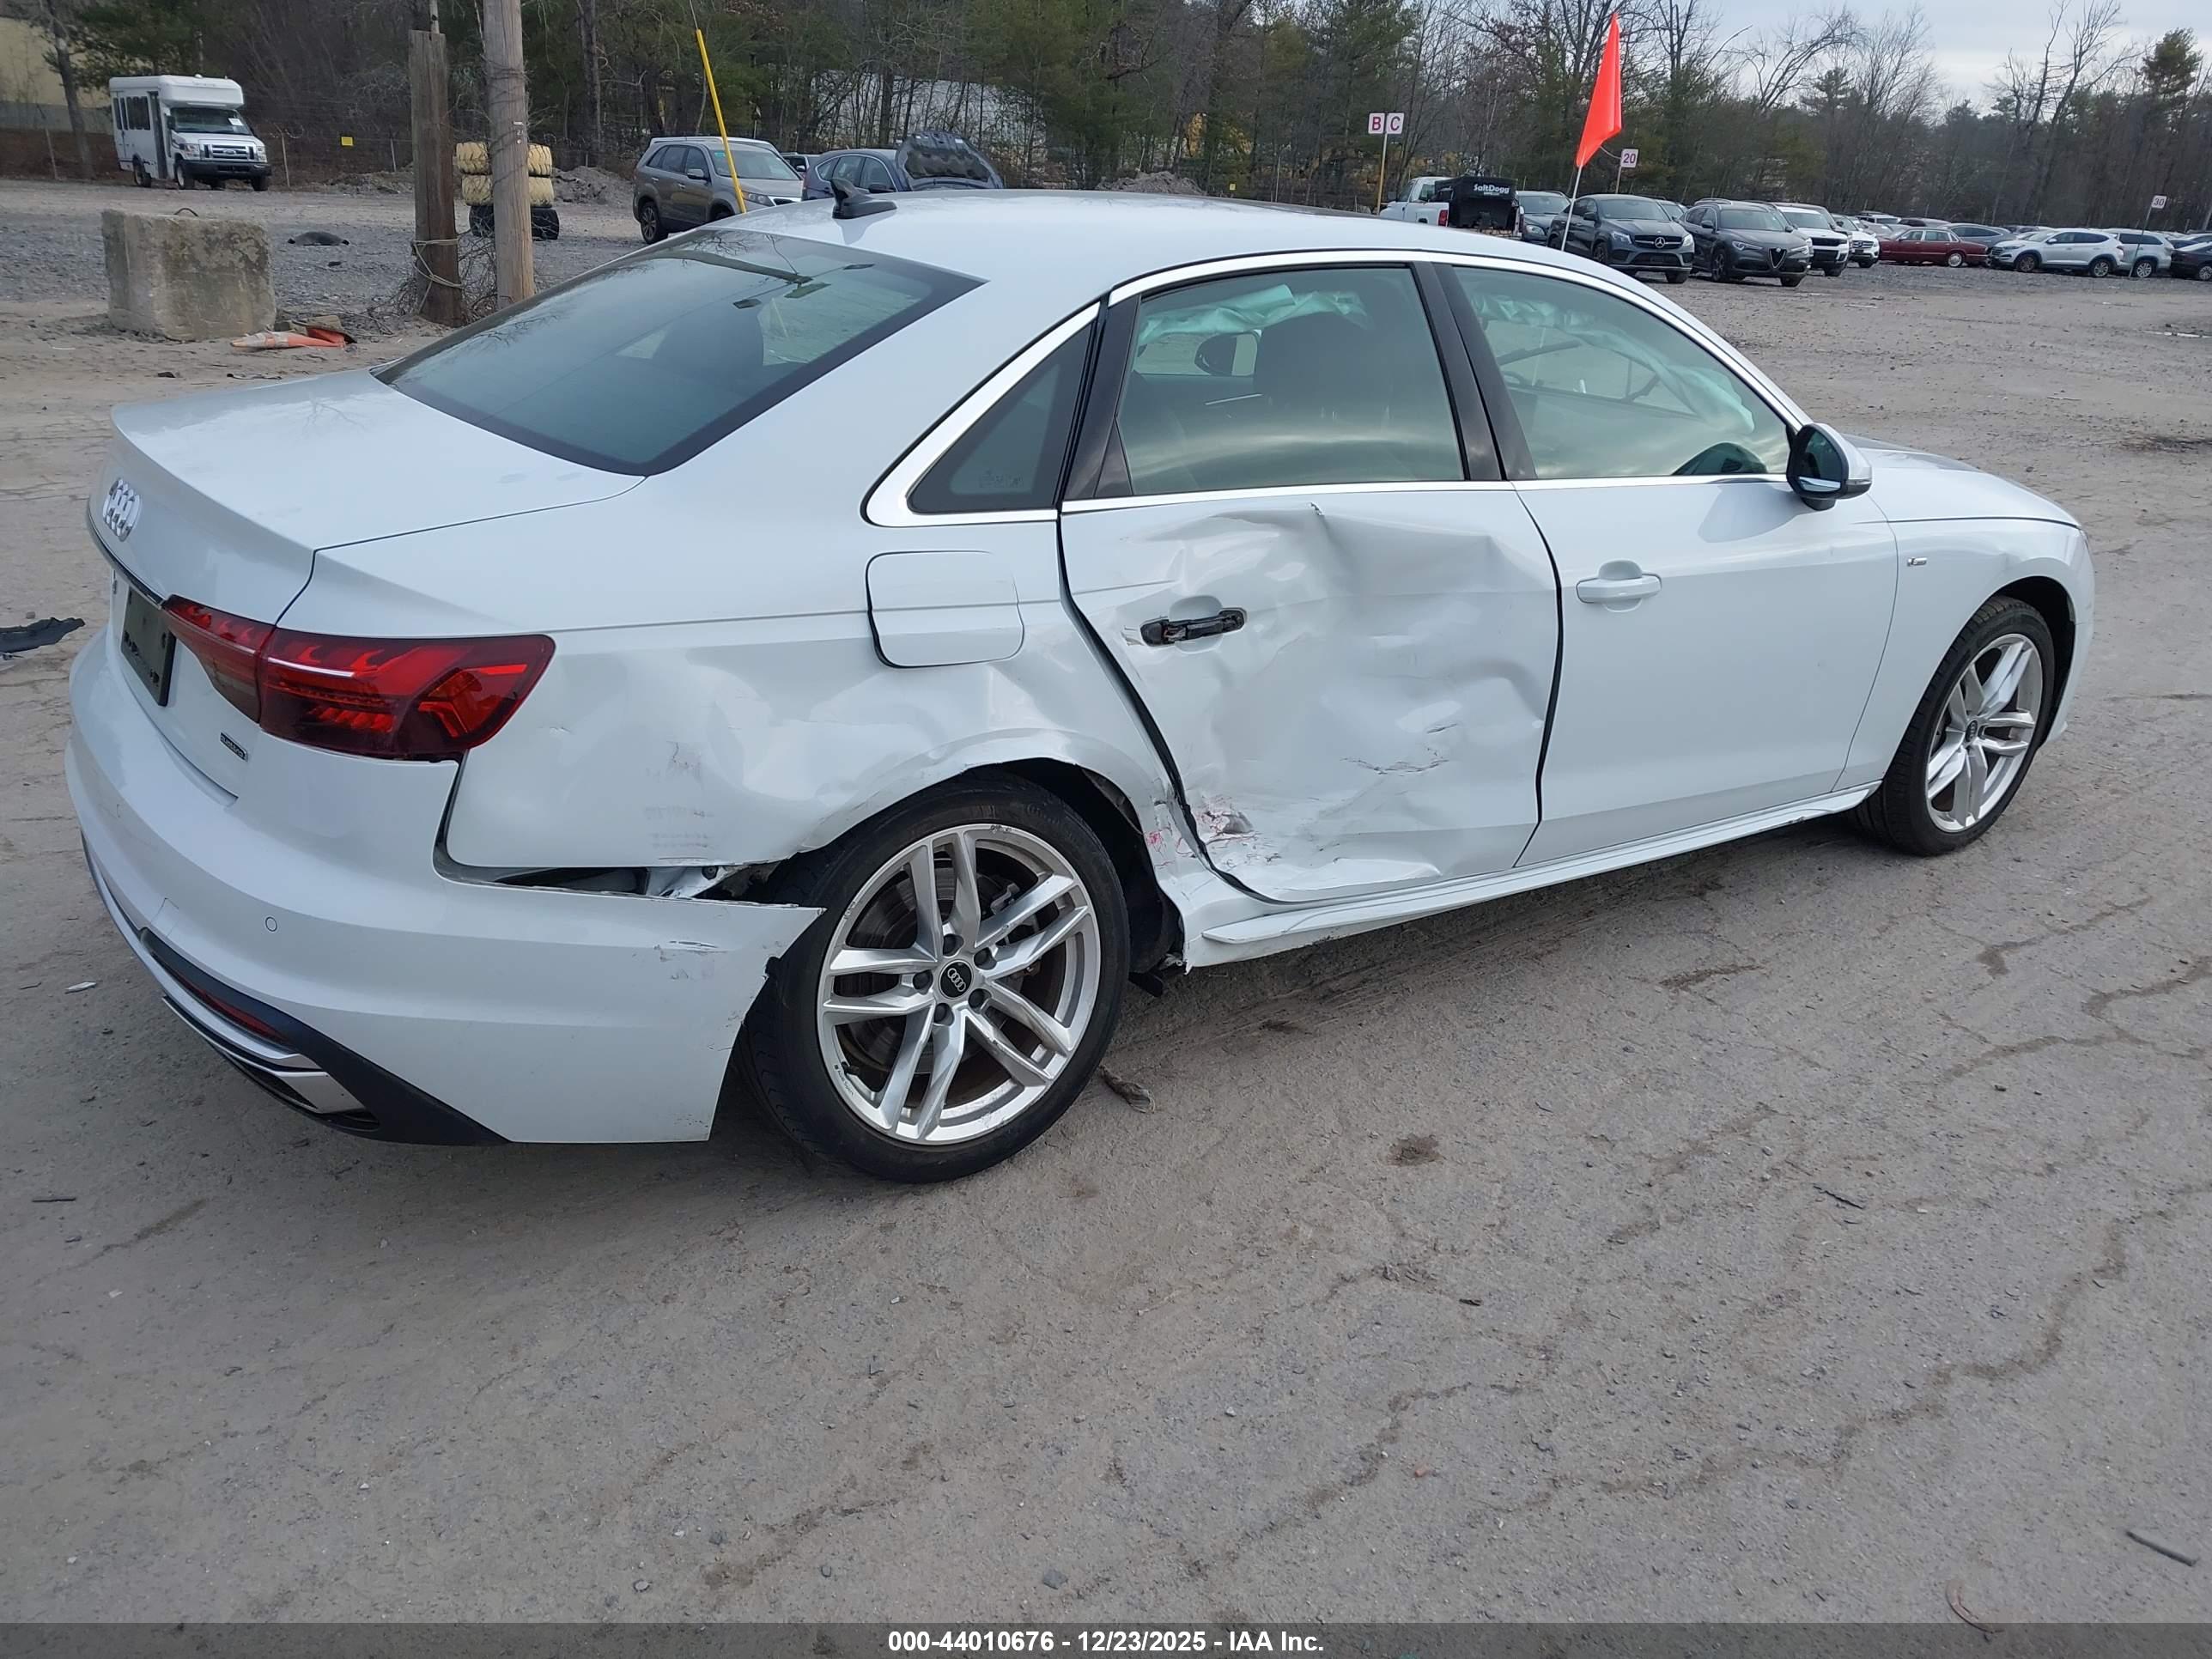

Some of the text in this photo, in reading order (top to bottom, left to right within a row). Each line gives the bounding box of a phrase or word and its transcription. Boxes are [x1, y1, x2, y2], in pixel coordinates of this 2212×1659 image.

[1372, 116, 1382, 131] B
[1390, 116, 1401, 131] C
[1623, 153, 1637, 164] 20
[1473, 183, 1510, 195] SaltDogg
